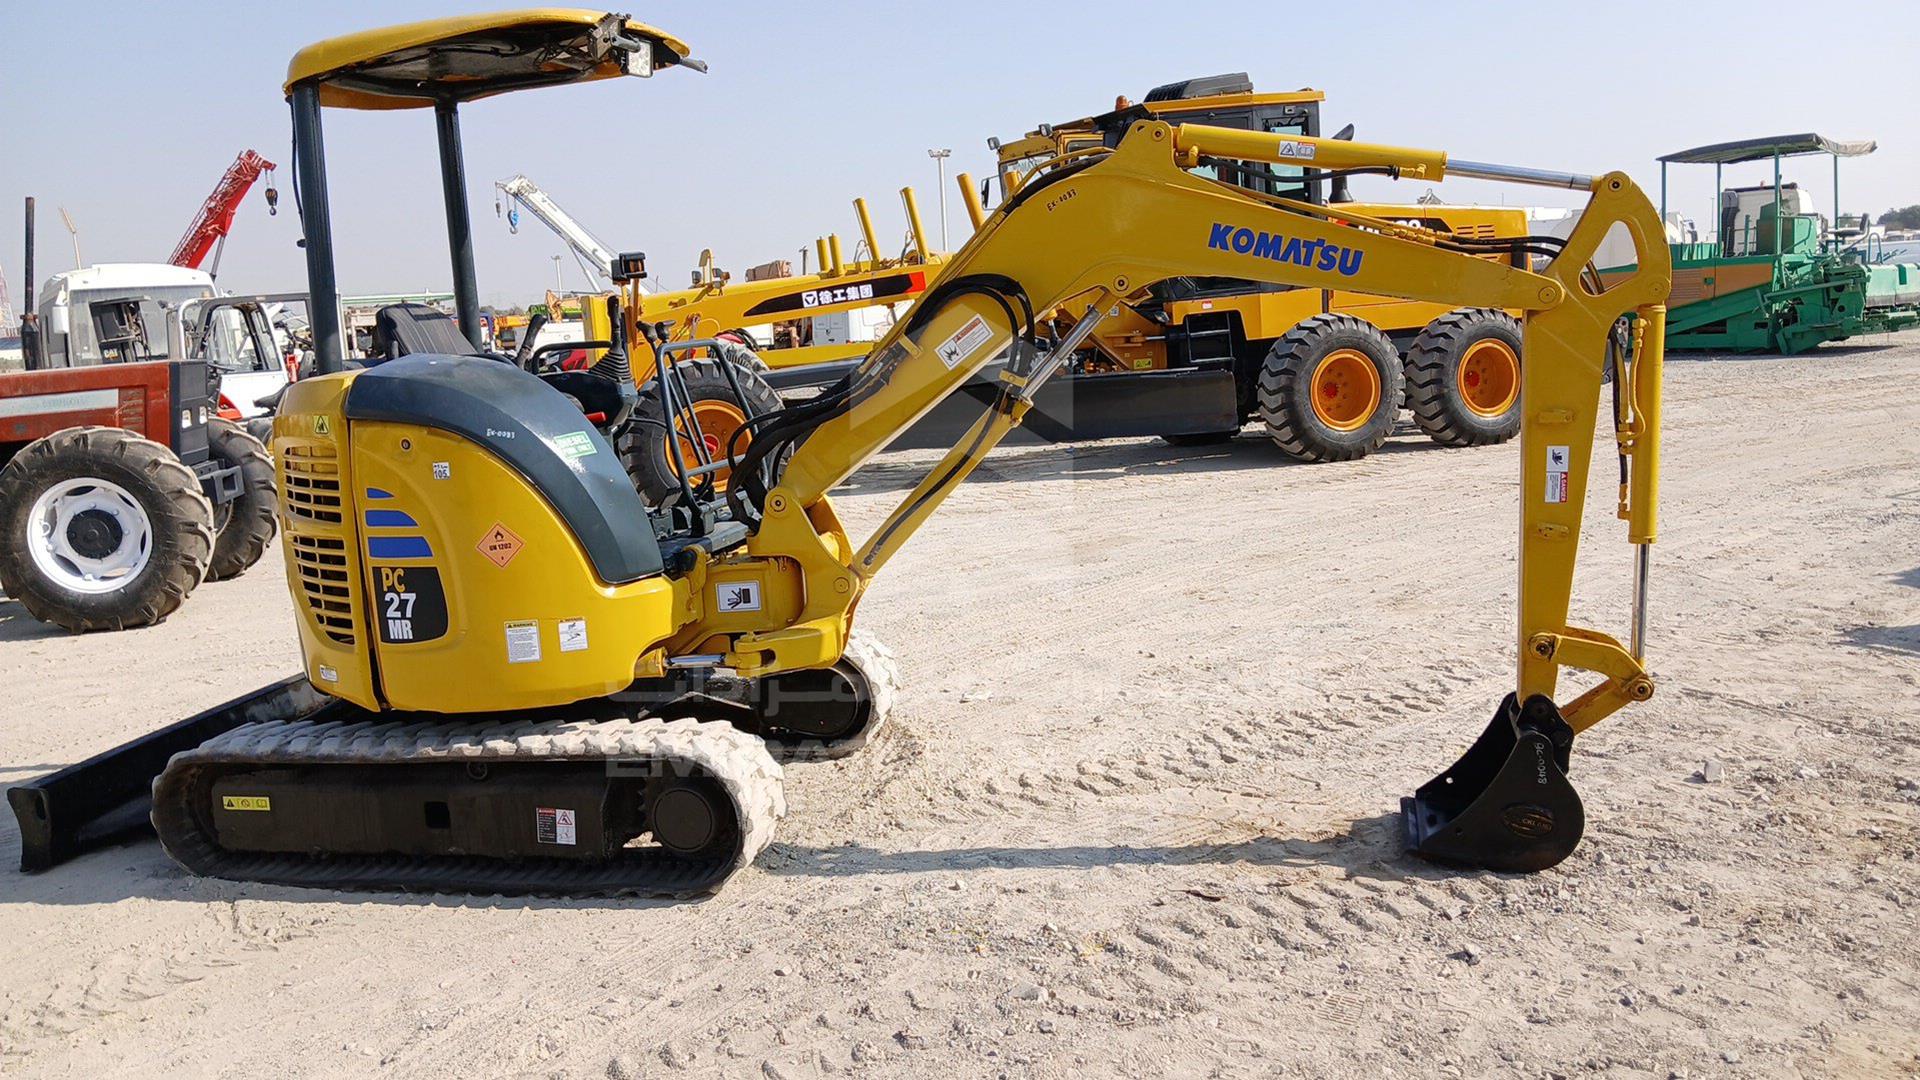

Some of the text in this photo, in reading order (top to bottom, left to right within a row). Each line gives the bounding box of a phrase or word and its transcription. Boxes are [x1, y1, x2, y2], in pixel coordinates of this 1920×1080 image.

[1208, 222, 1364, 276] KOMATSU
[381, 567, 406, 593] PC
[384, 592, 417, 618] 27
[387, 619, 414, 640] MR
